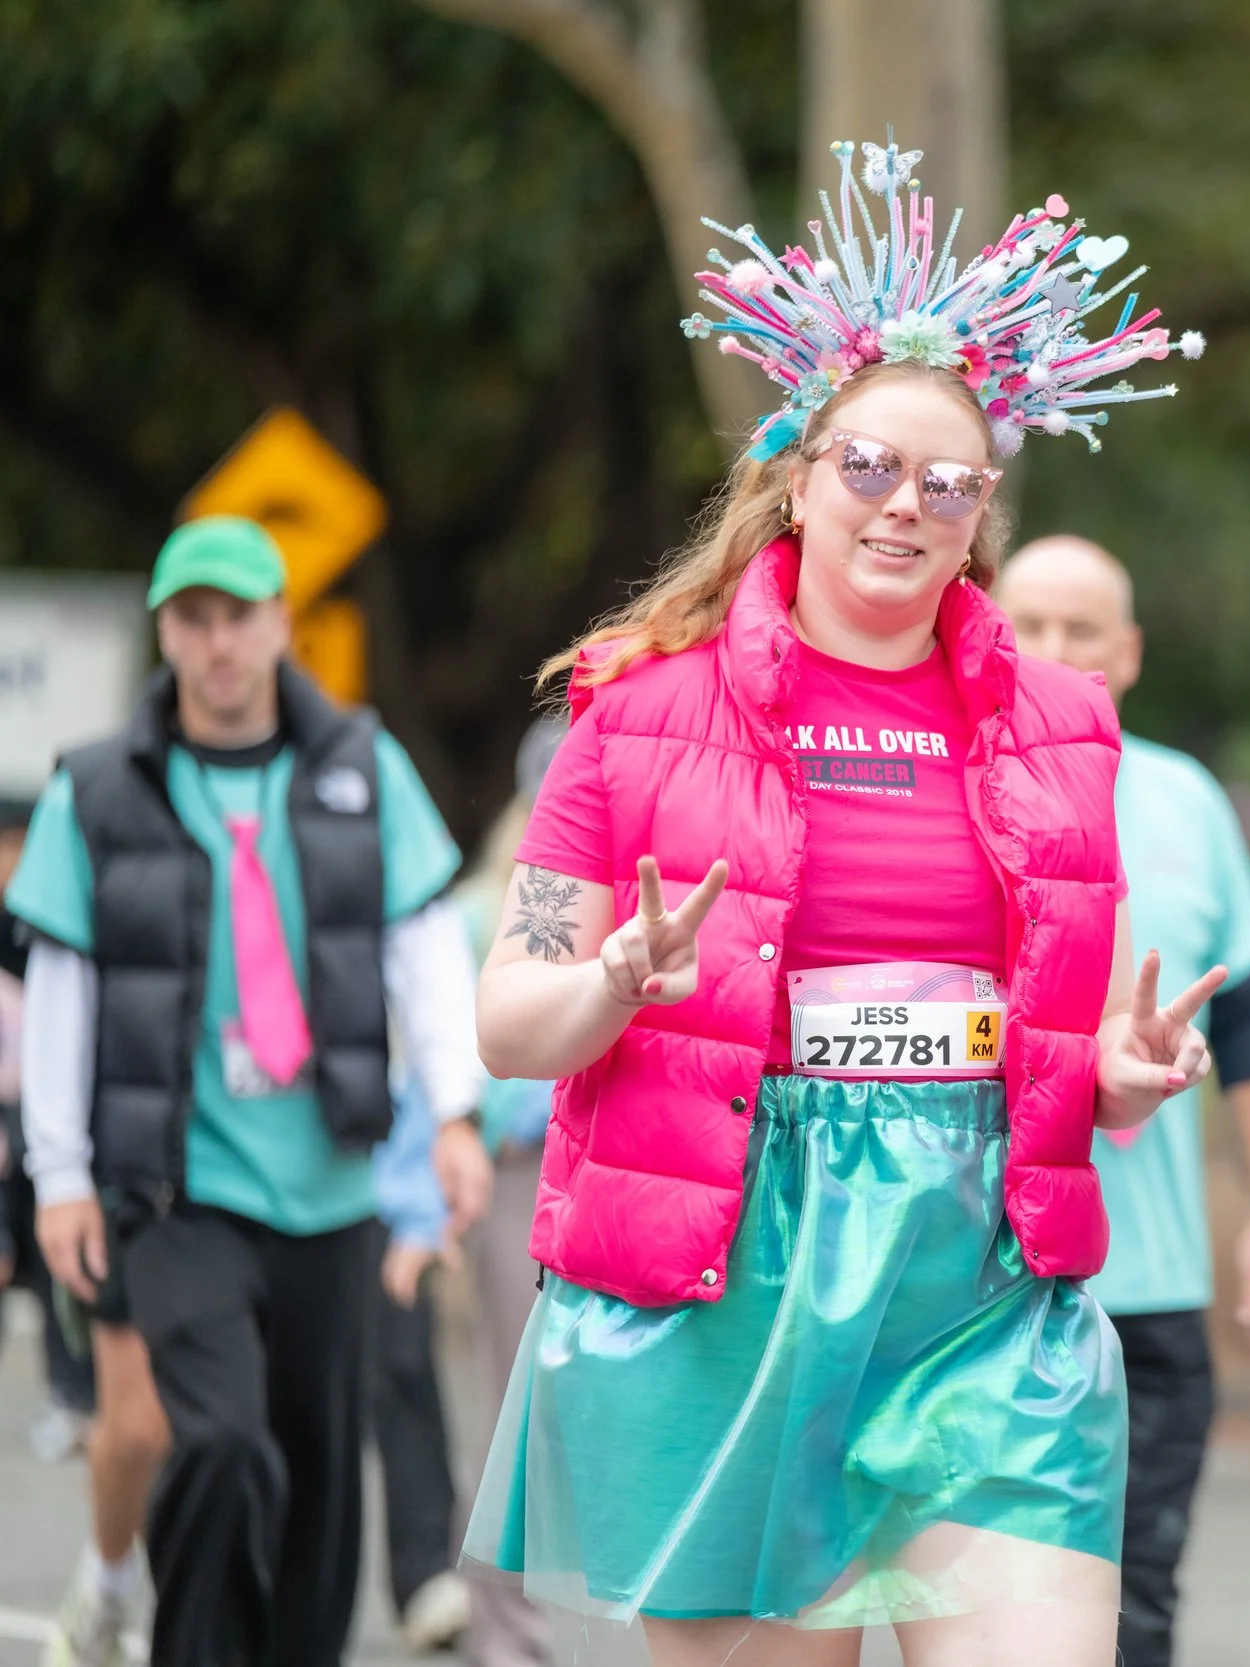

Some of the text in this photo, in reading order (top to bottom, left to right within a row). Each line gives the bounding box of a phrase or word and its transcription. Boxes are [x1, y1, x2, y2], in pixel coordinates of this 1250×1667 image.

[824, 726, 872, 752] ALL
[879, 729, 950, 757] OVER
[801, 761, 910, 783] ST CANCER
[809, 781, 913, 798] DAY CLASSIC 2018
[851, 1007, 910, 1026] JESS
[975, 1015, 992, 1038] 4
[806, 1034, 951, 1066] 272781
[972, 1043, 993, 1057] KM
